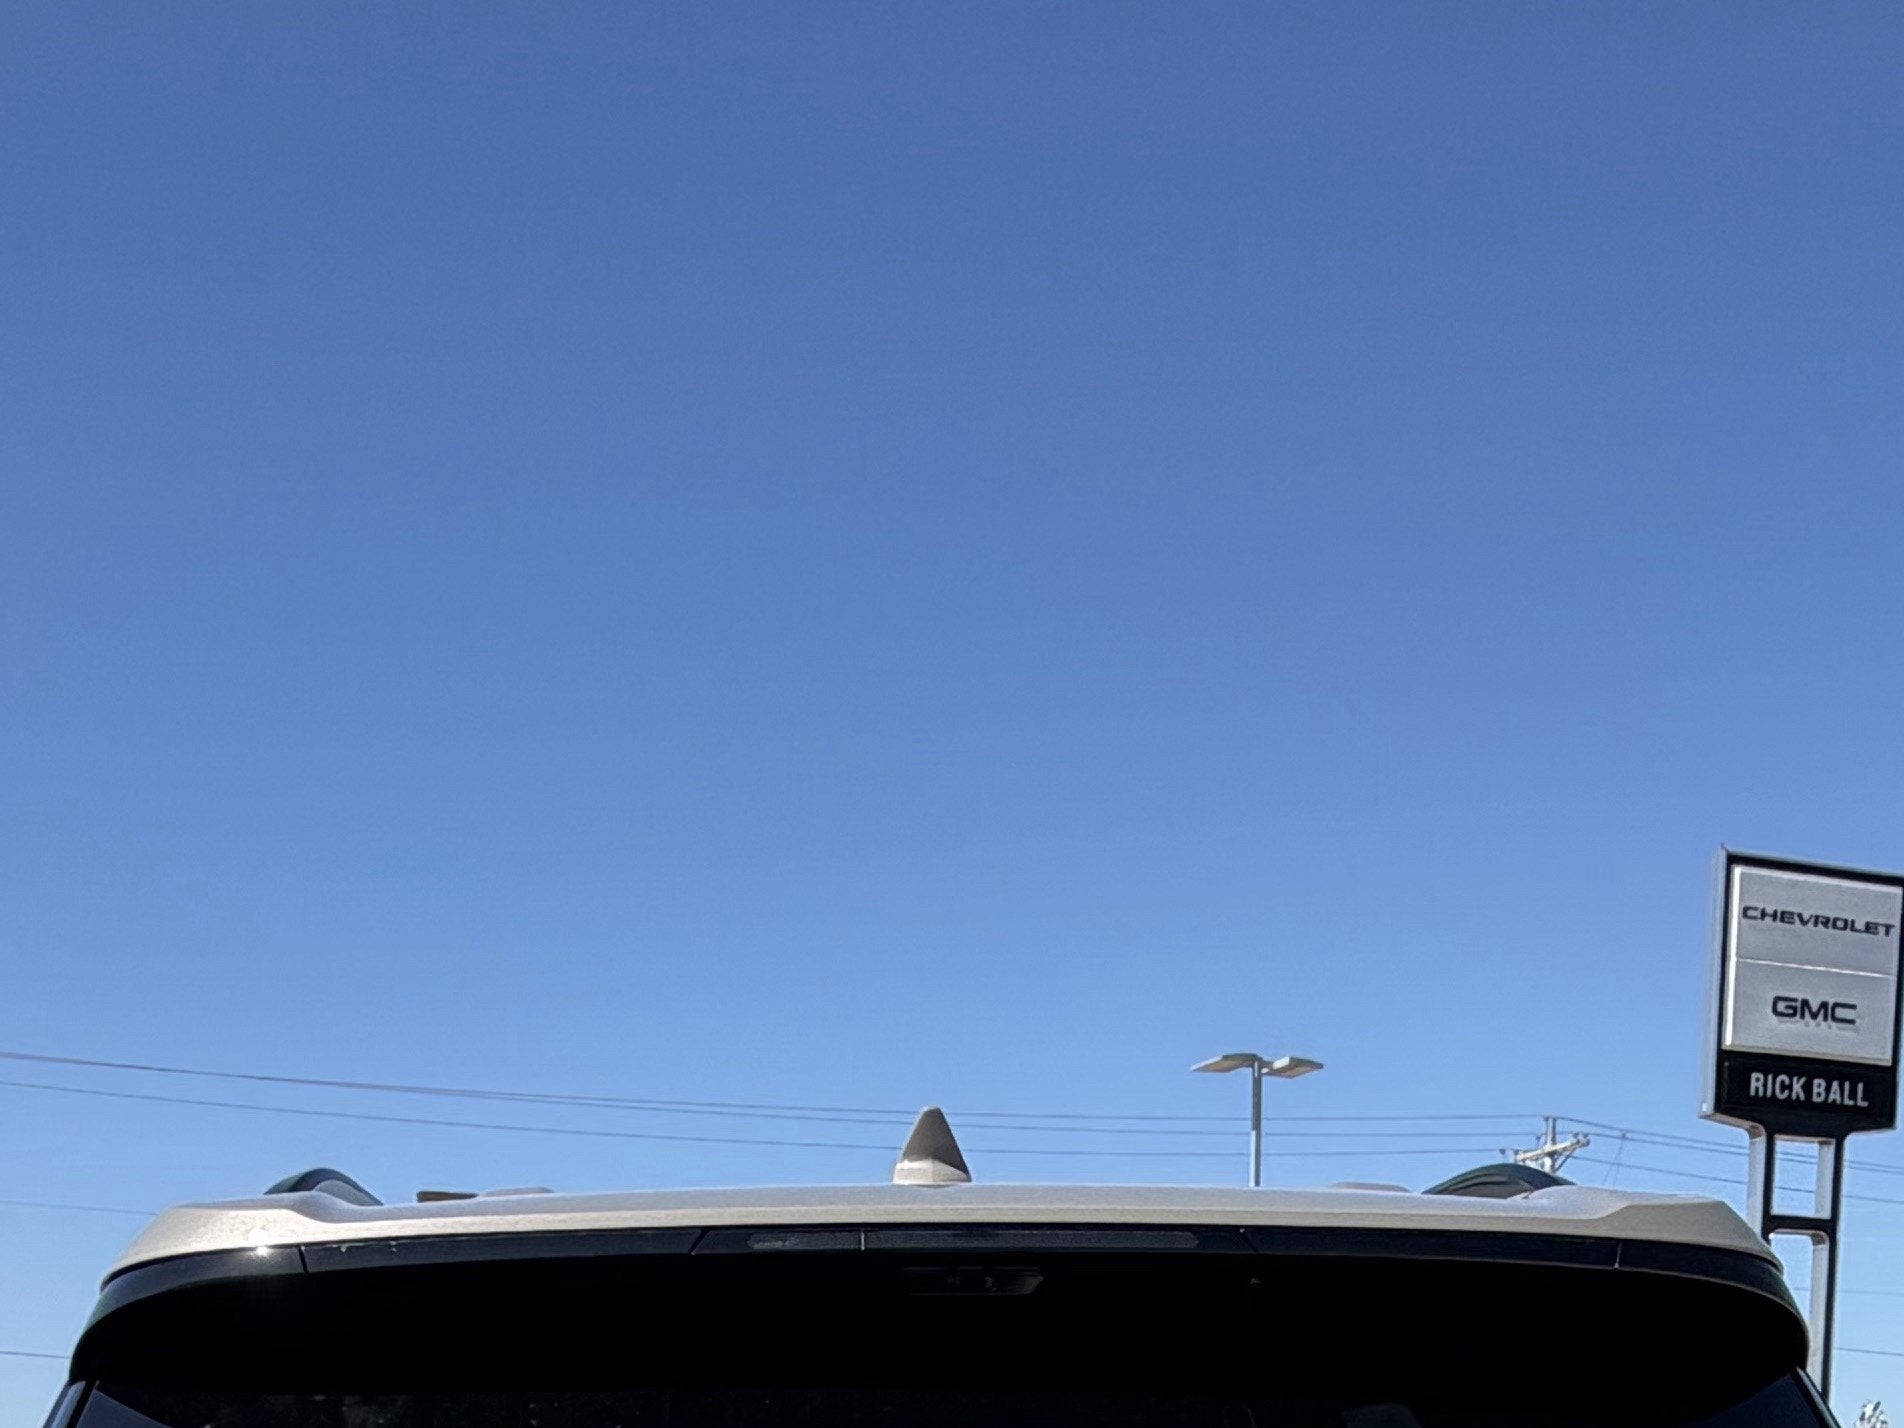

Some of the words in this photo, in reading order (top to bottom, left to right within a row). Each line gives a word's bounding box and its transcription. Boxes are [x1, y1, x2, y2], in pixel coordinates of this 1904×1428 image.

[1742, 905, 1896, 938] CHEVROLET
[1771, 995, 1858, 1025] GMC
[1749, 1071, 1807, 1102] RICK
[1812, 1078, 1870, 1108] BALL
